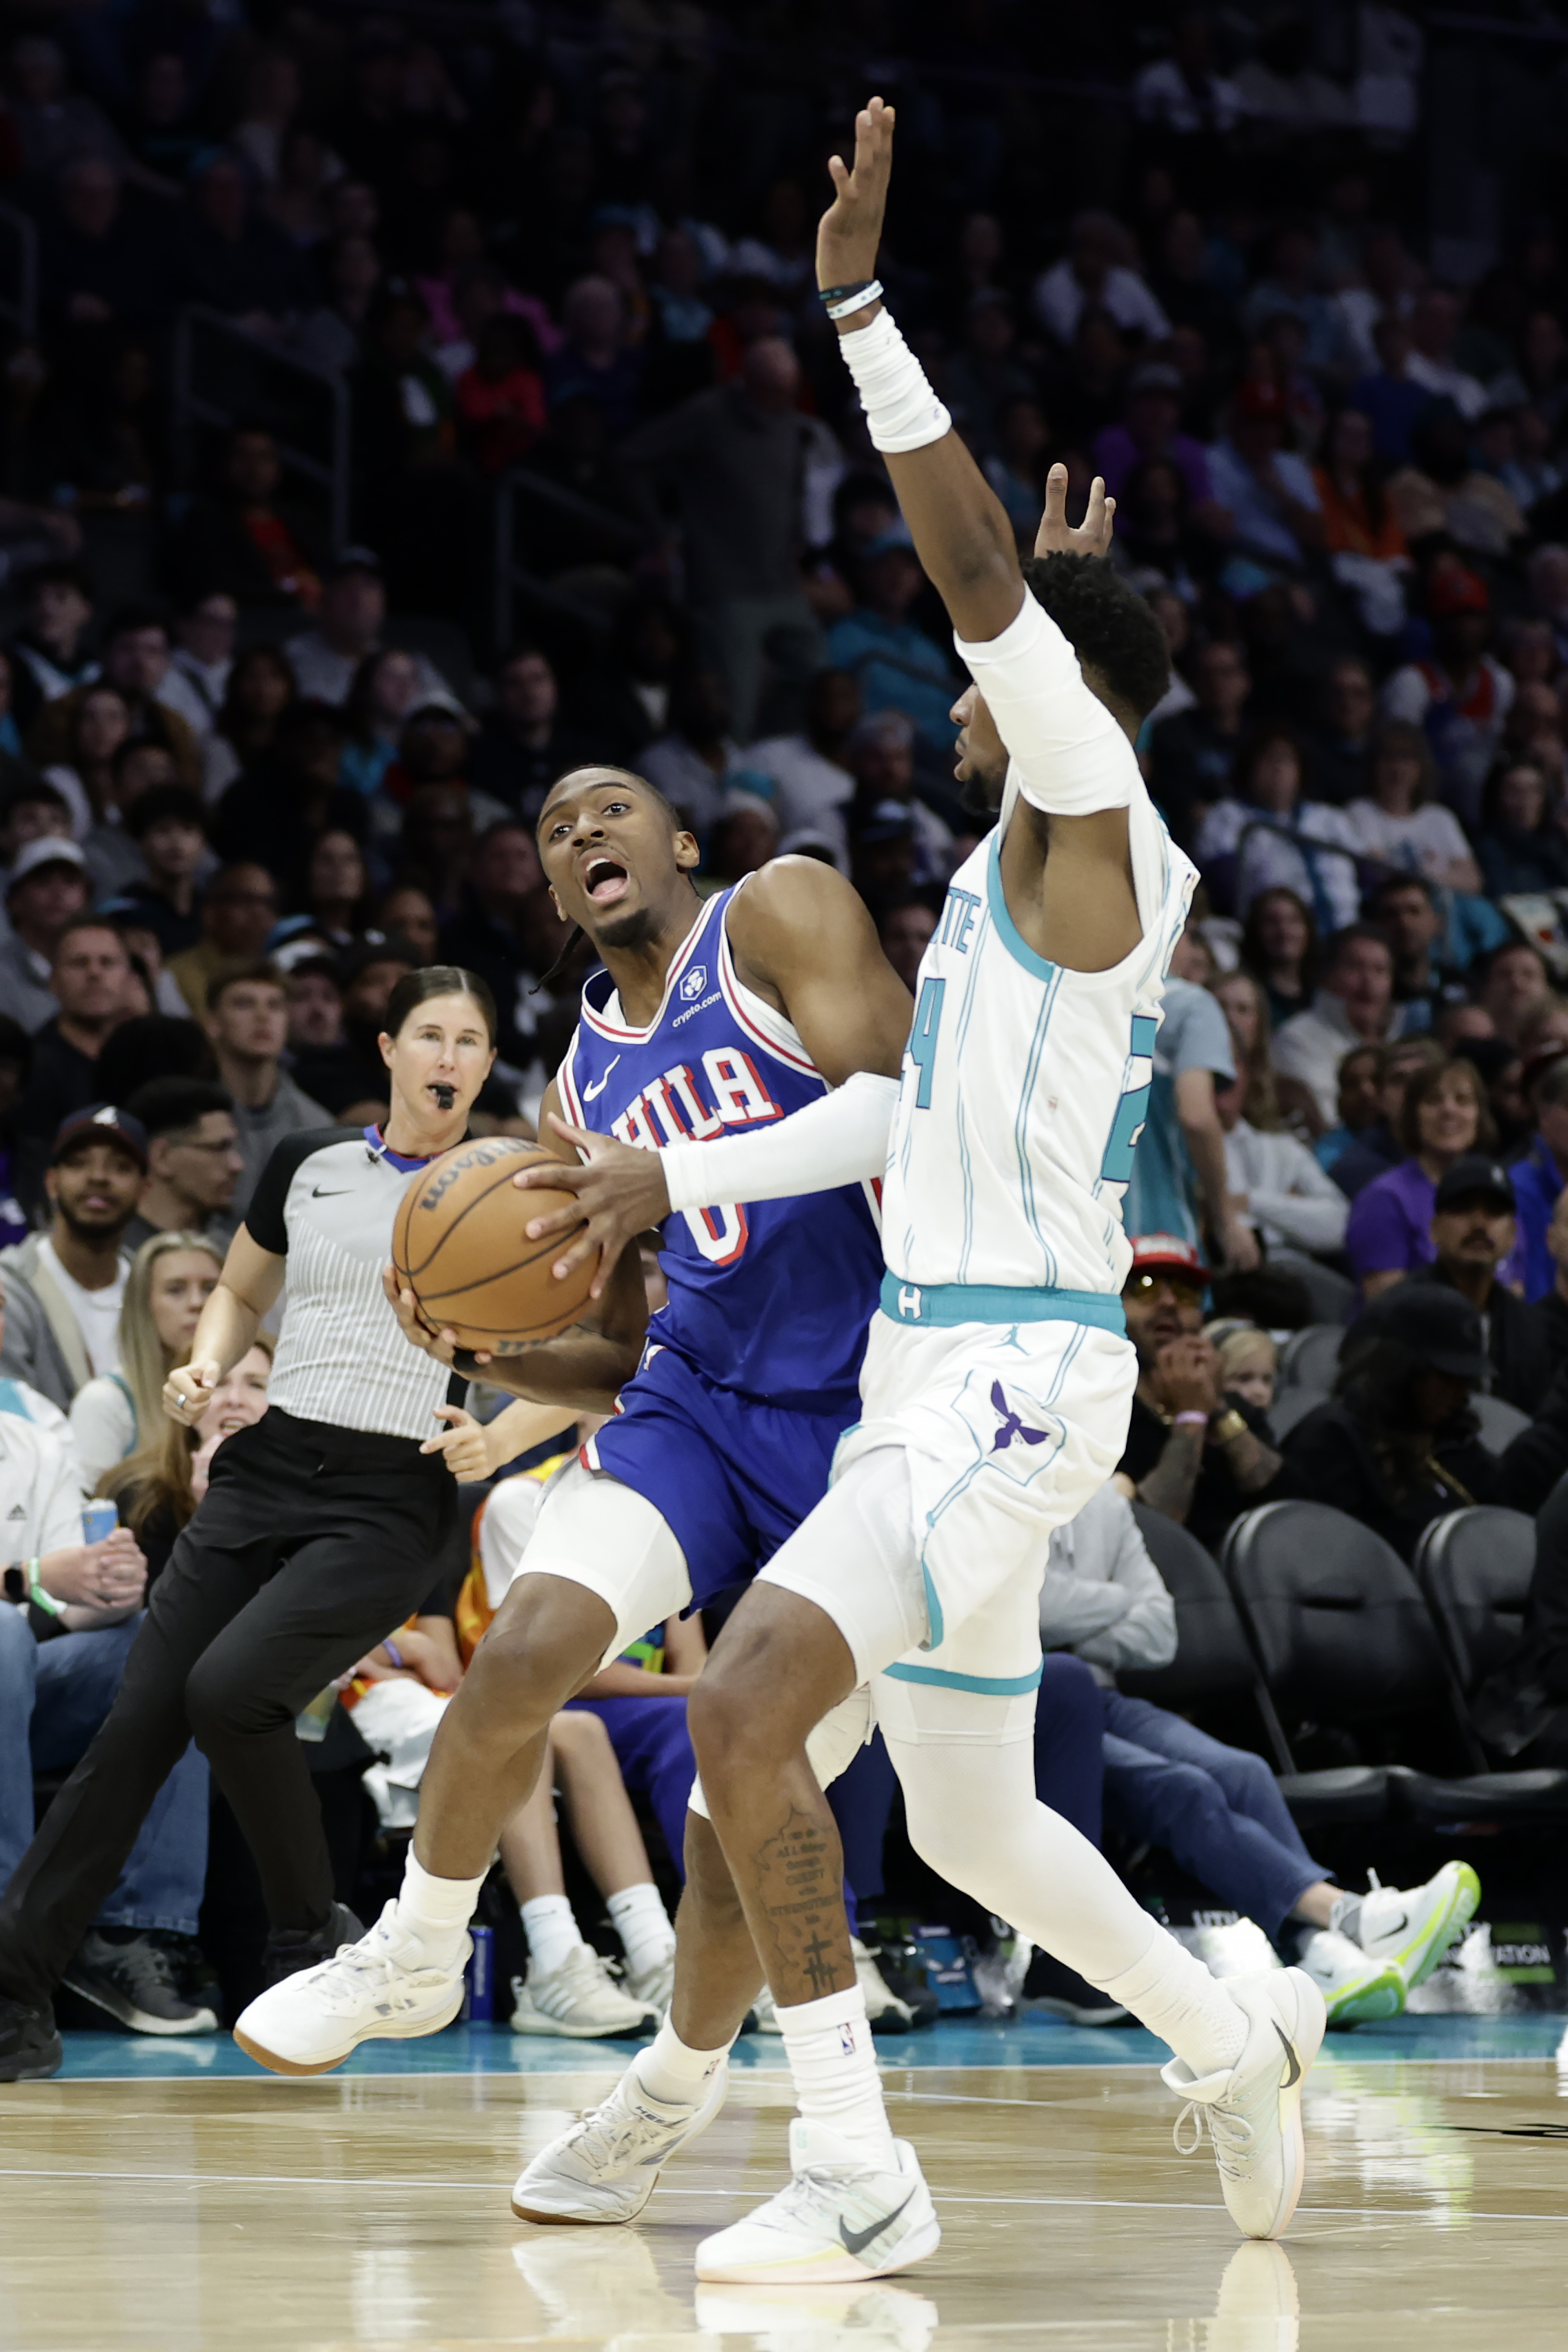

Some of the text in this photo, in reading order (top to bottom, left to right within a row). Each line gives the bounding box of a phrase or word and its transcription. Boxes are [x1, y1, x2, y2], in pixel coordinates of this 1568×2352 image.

[929, 886, 981, 954] TTE
[672, 992, 722, 1027] crypto.com
[610, 1046, 784, 1153] HILA
